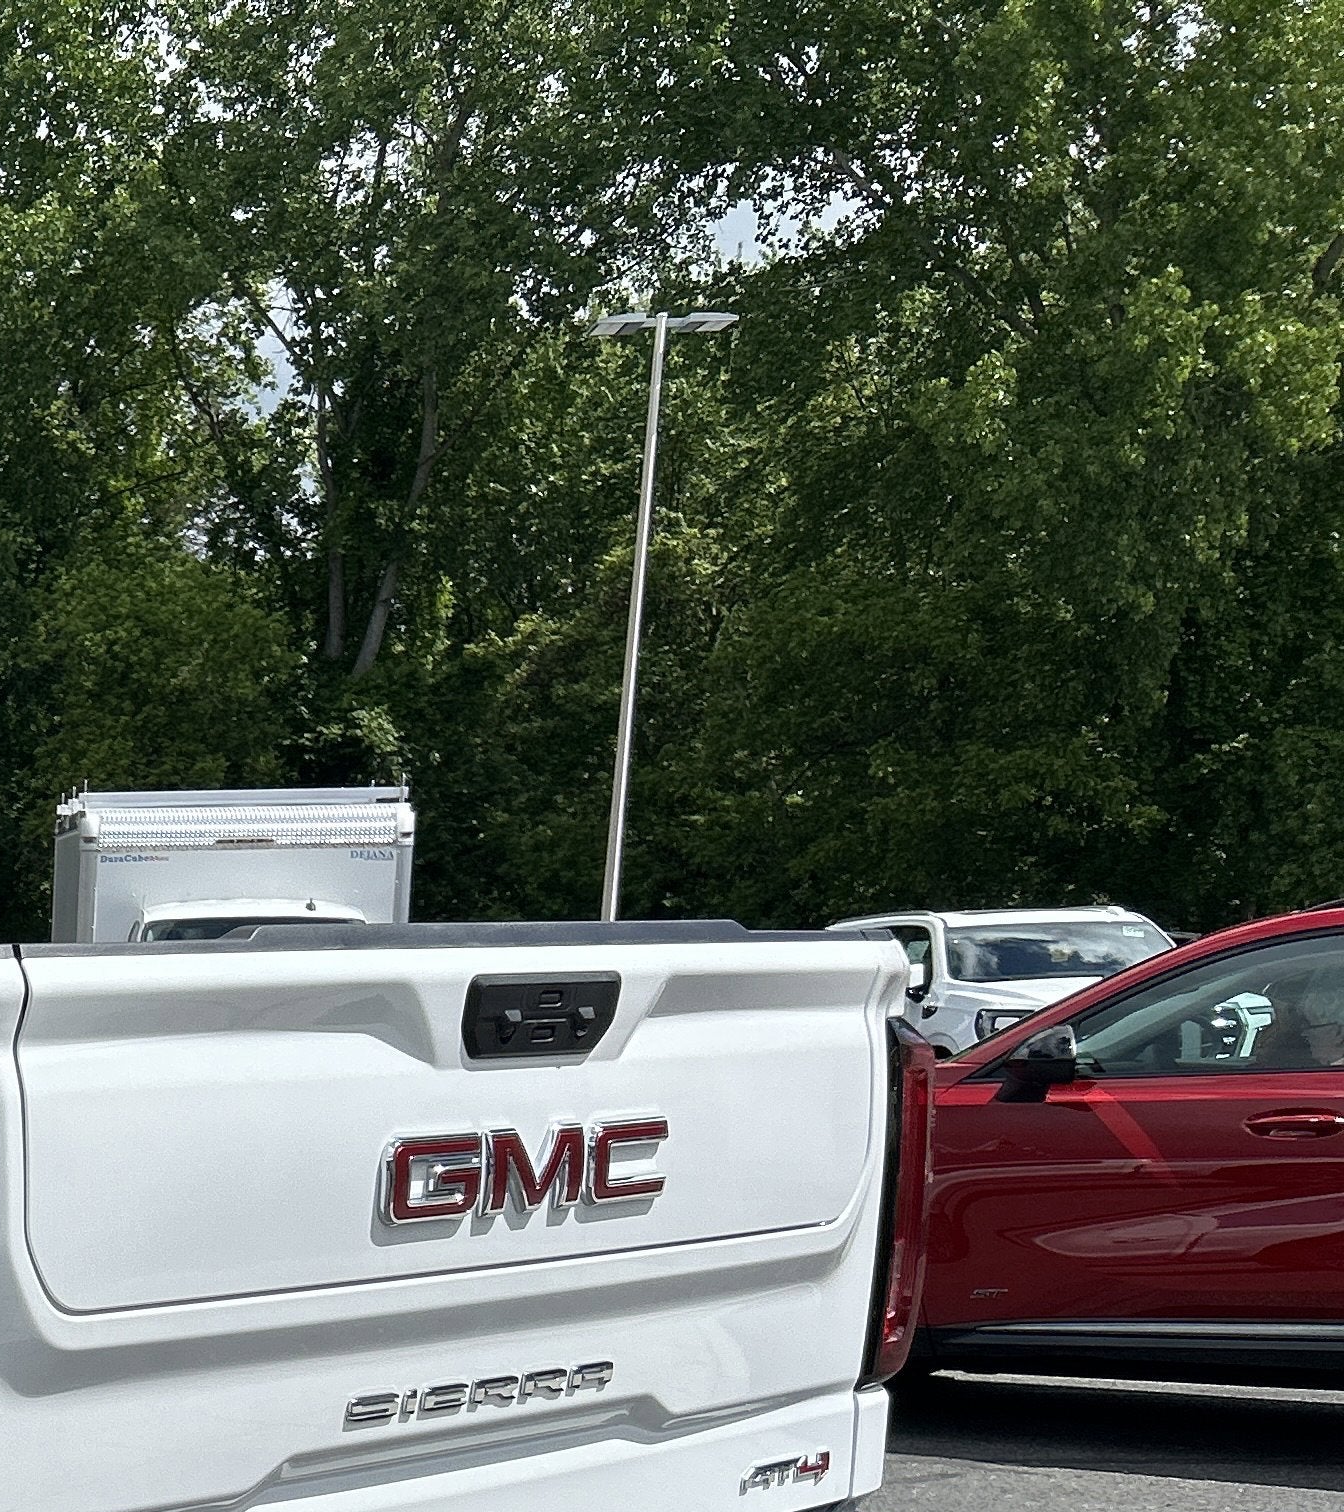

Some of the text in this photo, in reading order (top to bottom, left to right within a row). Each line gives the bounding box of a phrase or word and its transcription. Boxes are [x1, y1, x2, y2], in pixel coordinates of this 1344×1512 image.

[379, 1115, 669, 1227] GMC
[344, 1359, 615, 1424] SIERRA
[738, 1449, 830, 1496] AT4
